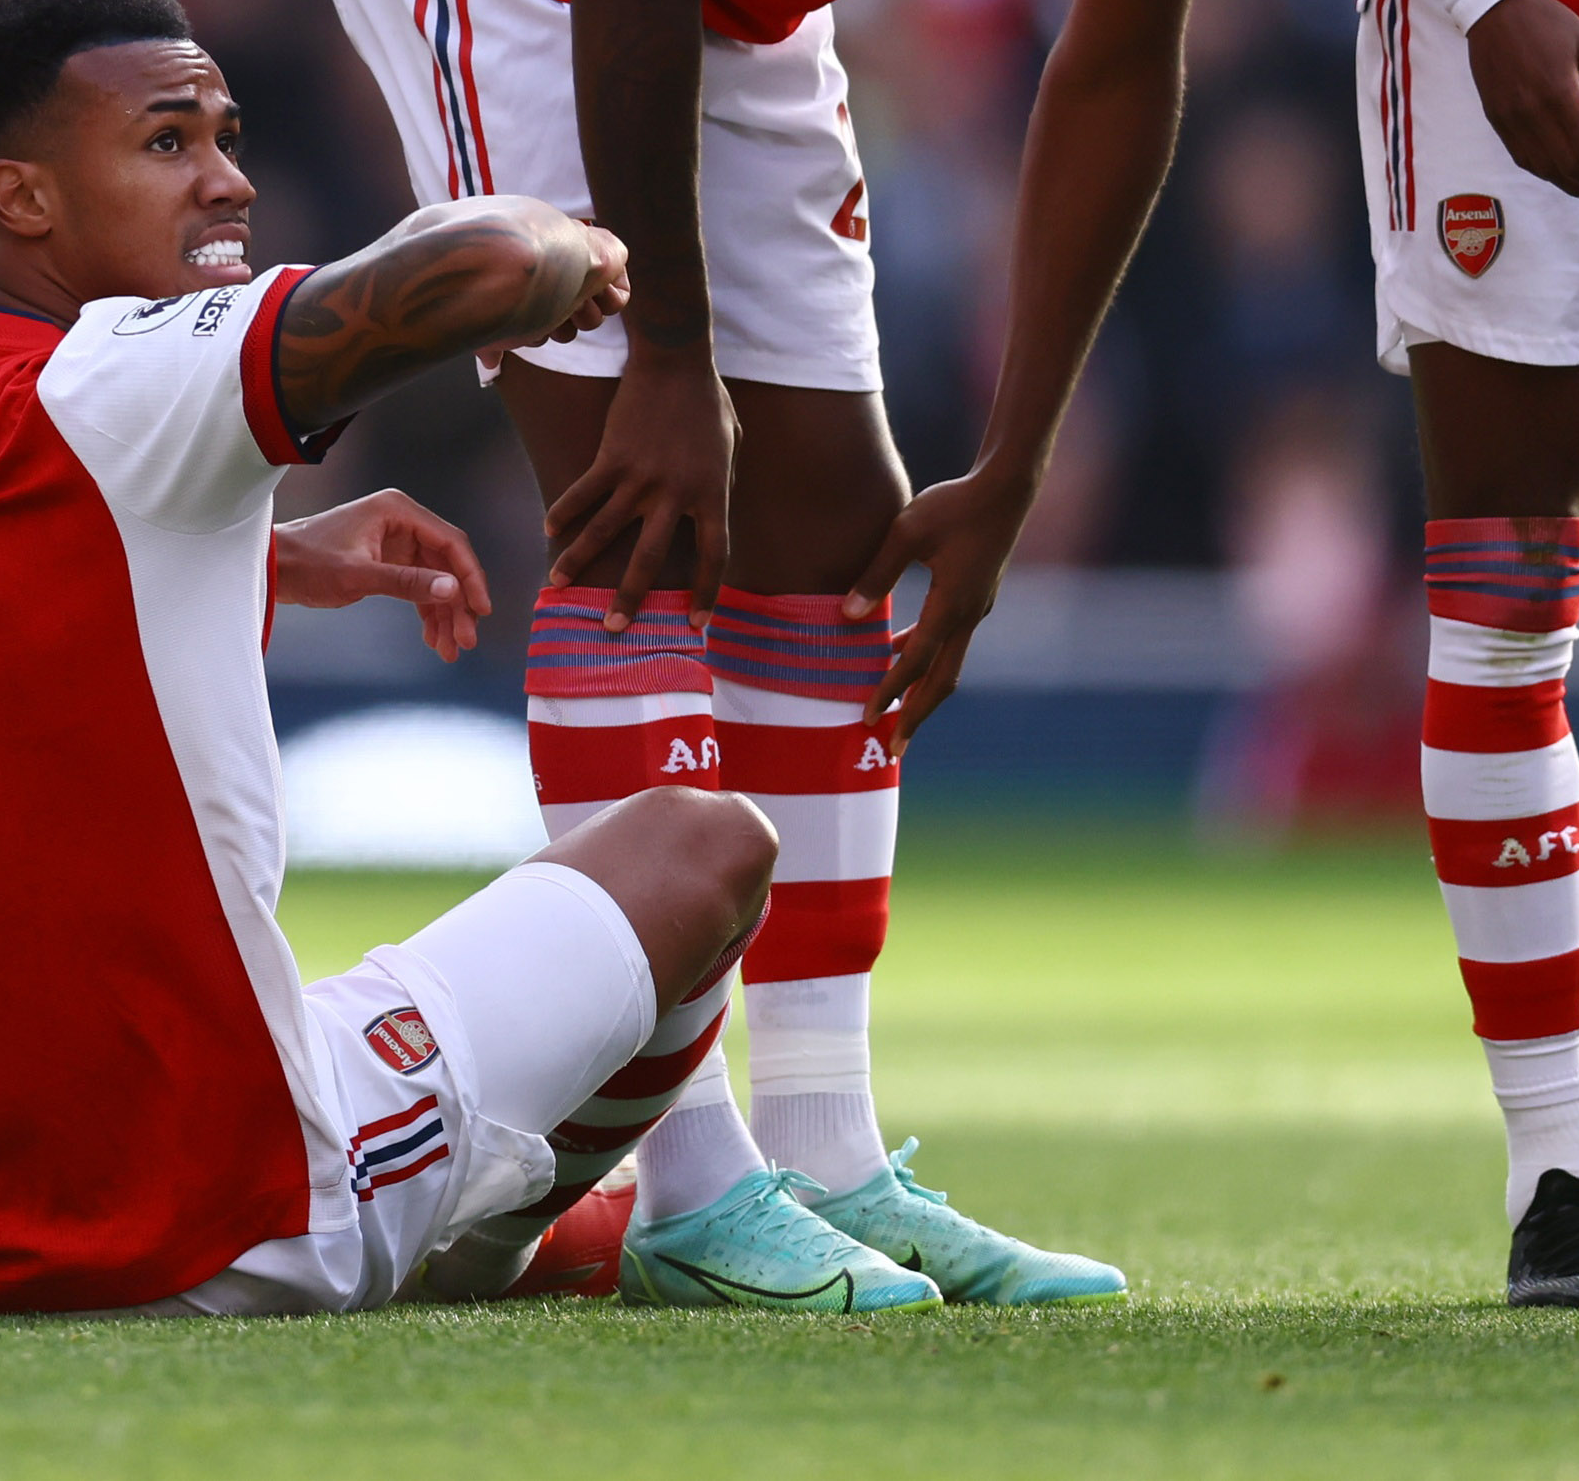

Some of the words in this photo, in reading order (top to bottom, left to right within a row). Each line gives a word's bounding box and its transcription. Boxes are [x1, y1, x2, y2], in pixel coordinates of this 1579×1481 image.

[1447, 206, 1494, 221] Arsenal
[660, 735, 722, 774] AF
[374, 1026, 416, 1067] Arsenal
